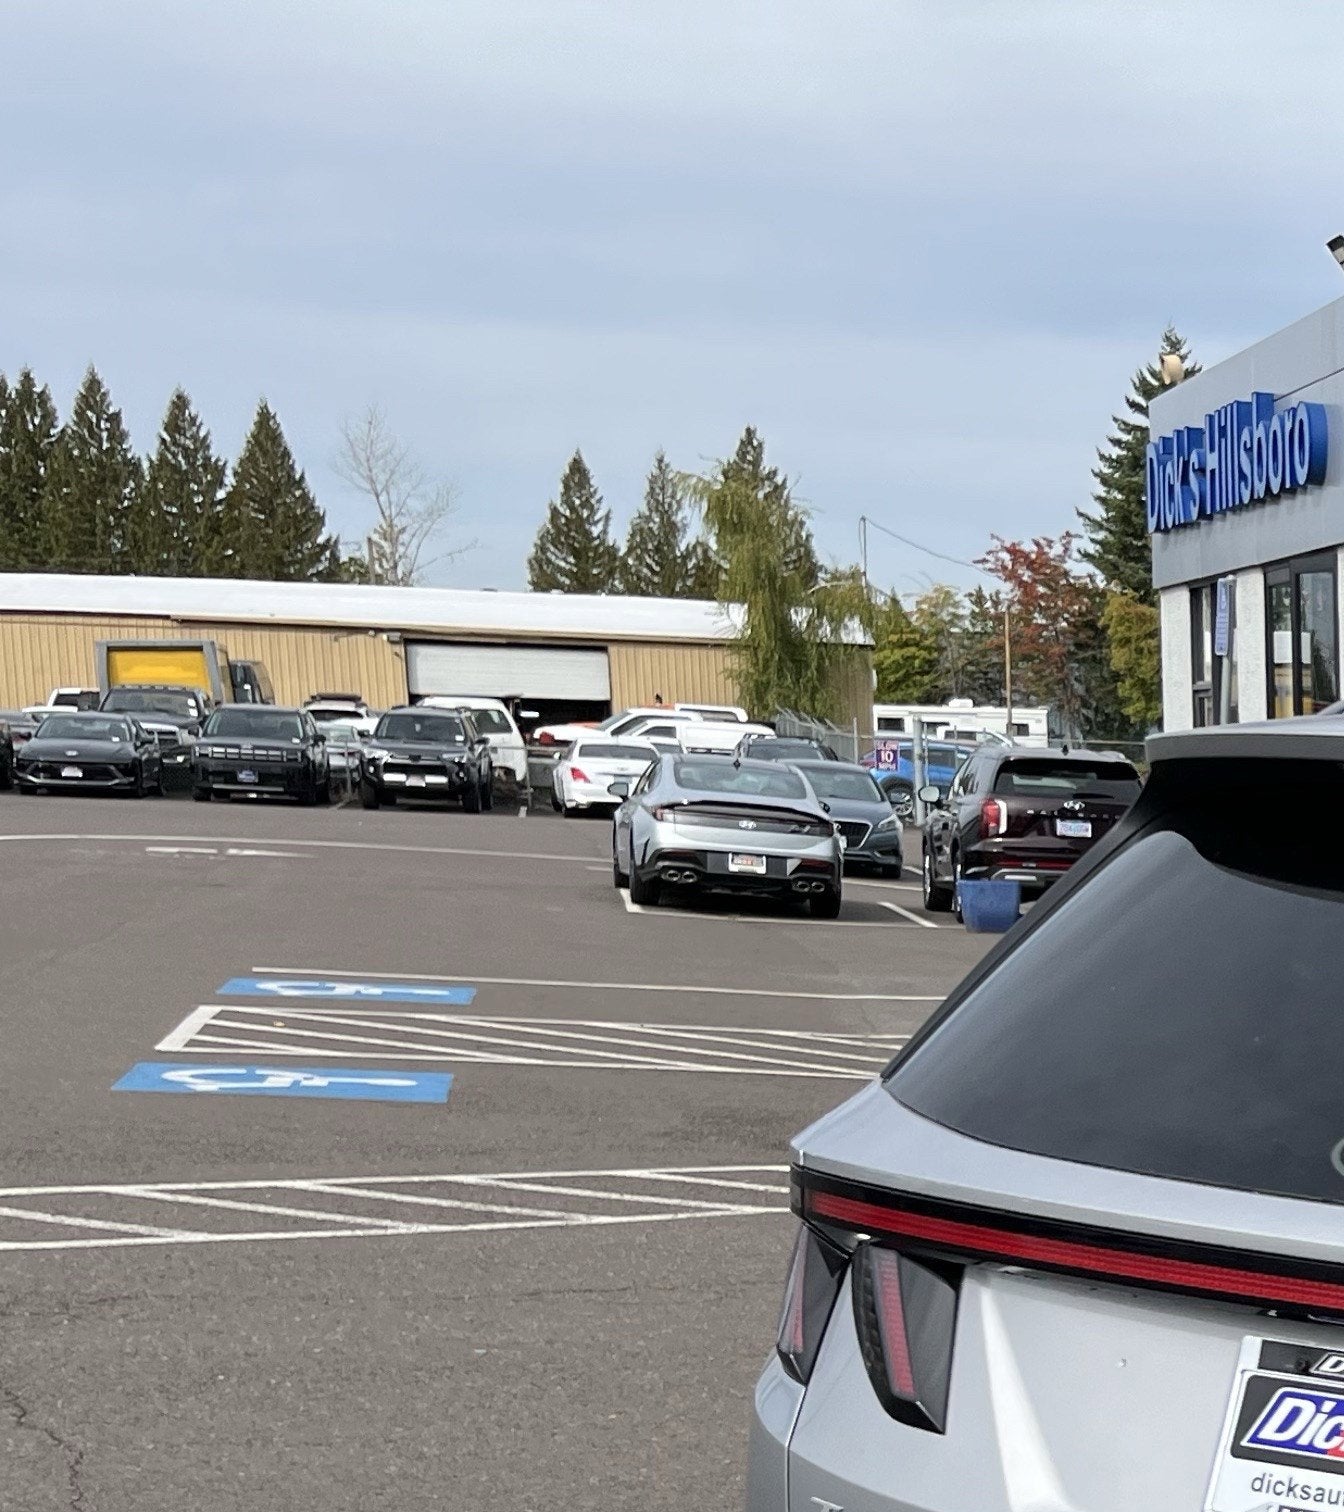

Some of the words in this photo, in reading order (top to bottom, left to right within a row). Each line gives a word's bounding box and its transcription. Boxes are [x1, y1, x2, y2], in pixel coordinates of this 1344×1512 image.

[1146, 426, 1202, 535] Dick's
[1204, 391, 1318, 515] Hillsboro
[880, 750, 894, 763] 10
